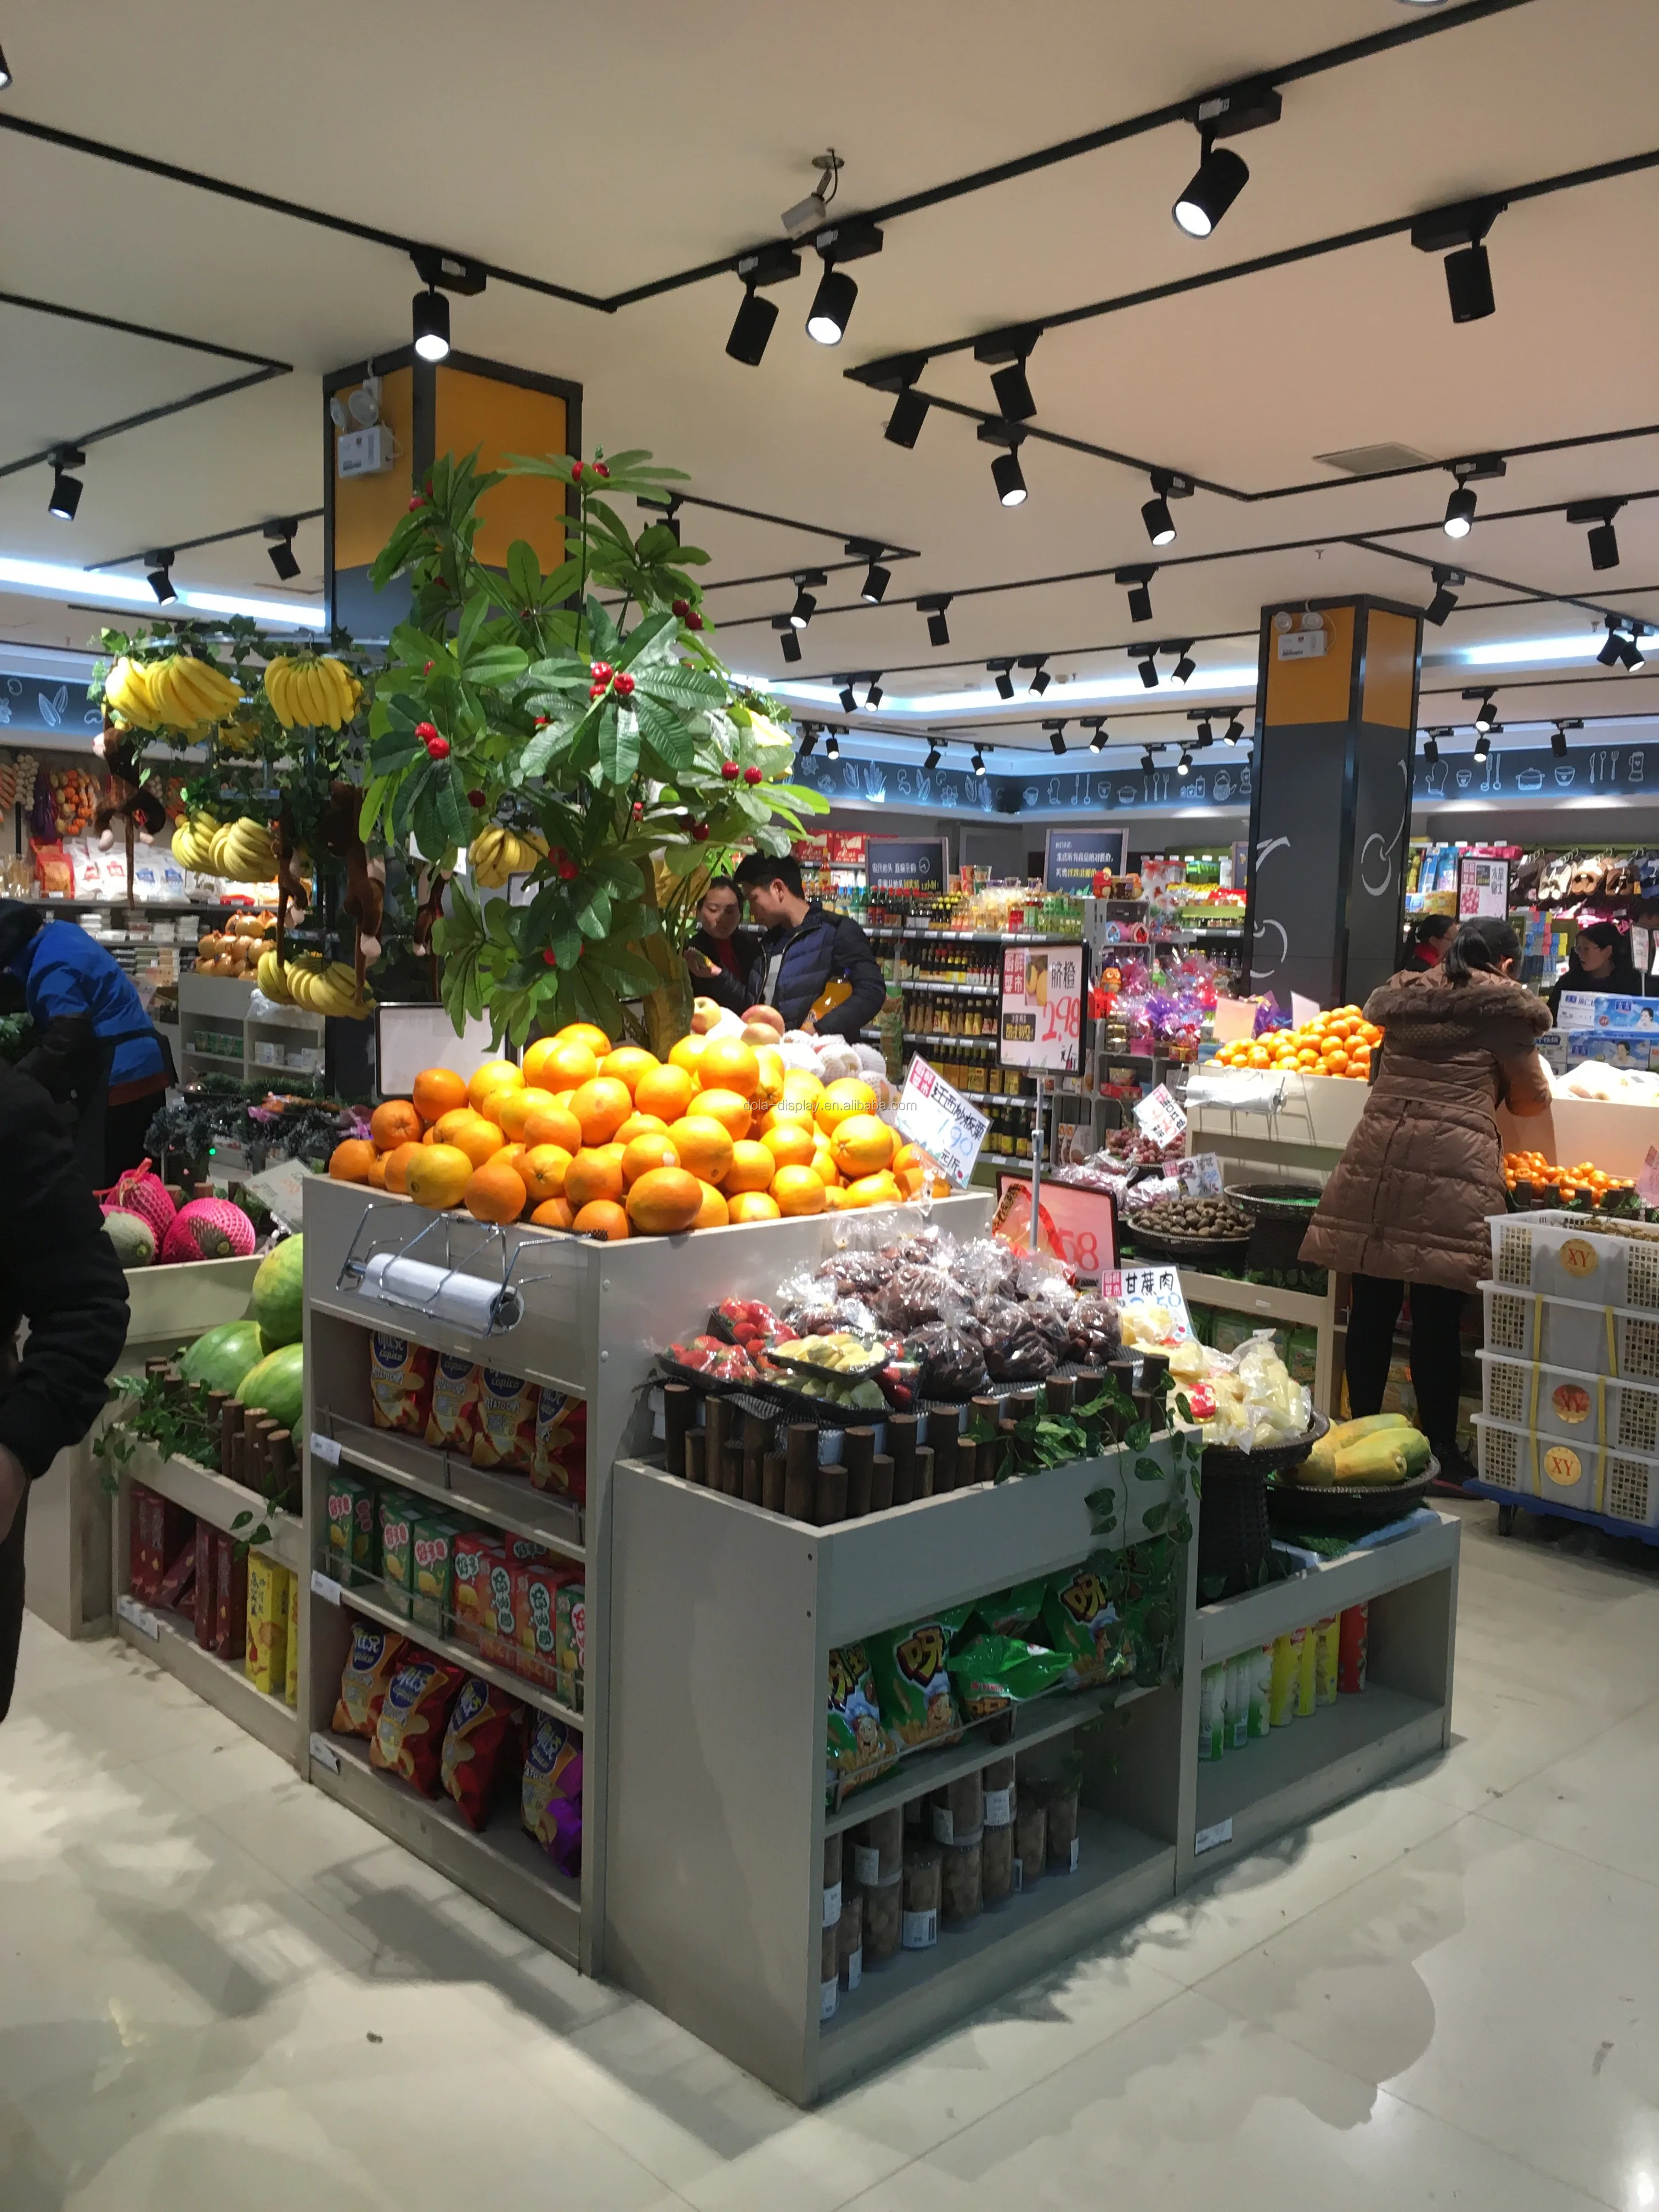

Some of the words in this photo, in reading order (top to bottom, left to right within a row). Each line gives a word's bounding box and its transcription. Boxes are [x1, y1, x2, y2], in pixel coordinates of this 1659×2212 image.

[1051, 961, 1076, 990] 脐橙
[1042, 996, 1080, 1042] 2.98
[1567, 1248, 1590, 1268] XY
[1125, 1269, 1174, 1296] 甘蔗肉
[491, 1376, 520, 1390] copico
[1552, 1456, 1574, 1477] XY
